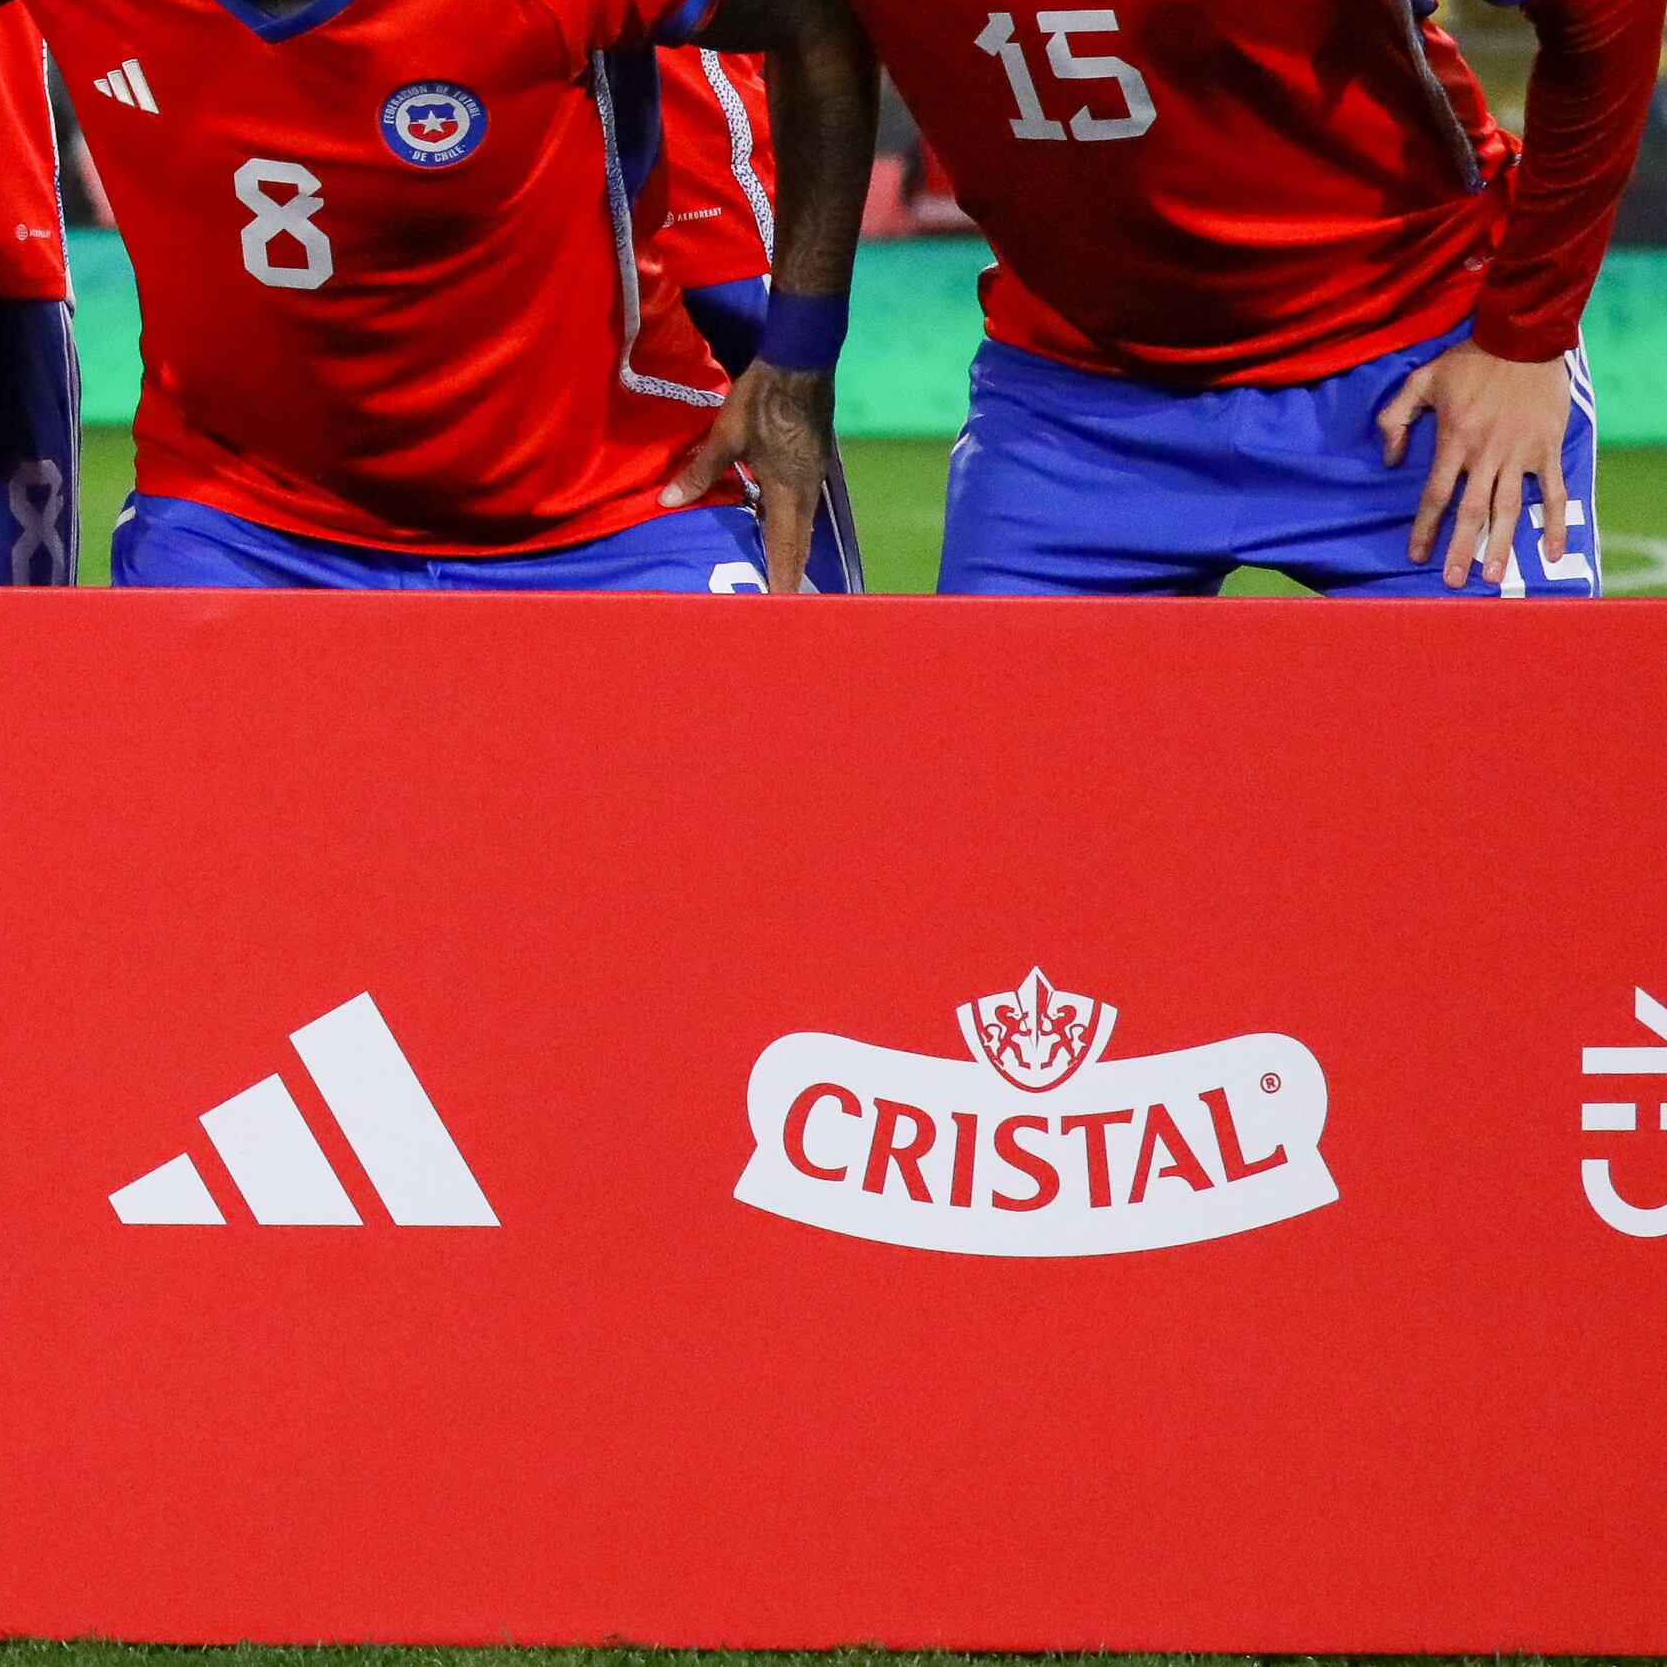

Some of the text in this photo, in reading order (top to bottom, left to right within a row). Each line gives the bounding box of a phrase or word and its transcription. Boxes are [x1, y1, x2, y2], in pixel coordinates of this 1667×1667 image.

[974, 9, 1158, 142] 15
[411, 145, 466, 163] DE CHILE
[234, 158, 333, 290] 8
[781, 1080, 1287, 1213] CRISTAL
